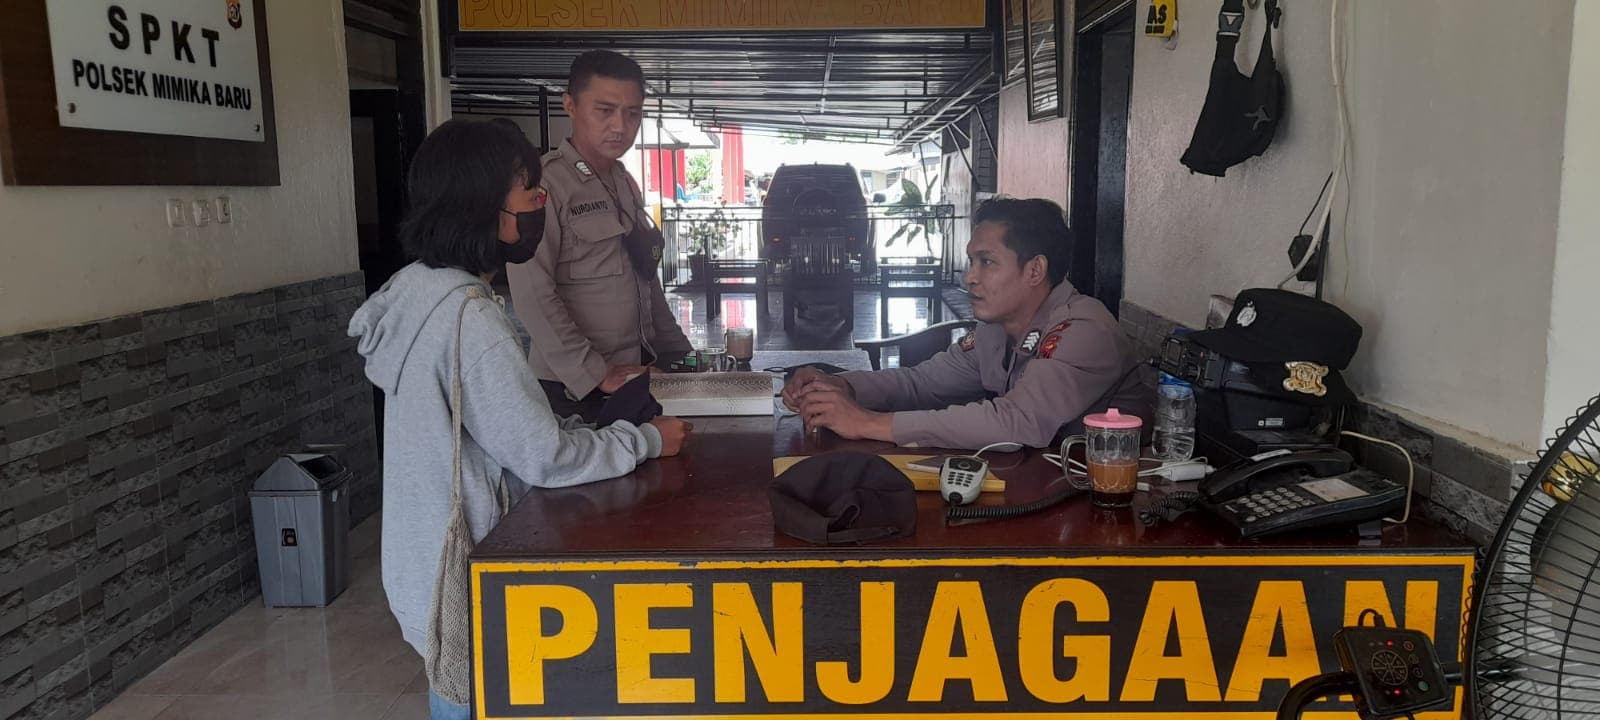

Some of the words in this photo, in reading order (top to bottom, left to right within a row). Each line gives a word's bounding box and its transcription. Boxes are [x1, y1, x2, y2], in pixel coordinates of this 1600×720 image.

[72, 59, 148, 97] POLSEK
[152, 73, 212, 105] MIMIKA
[215, 83, 252, 110] BARU
[570, 200, 608, 216] NURDIANTO
